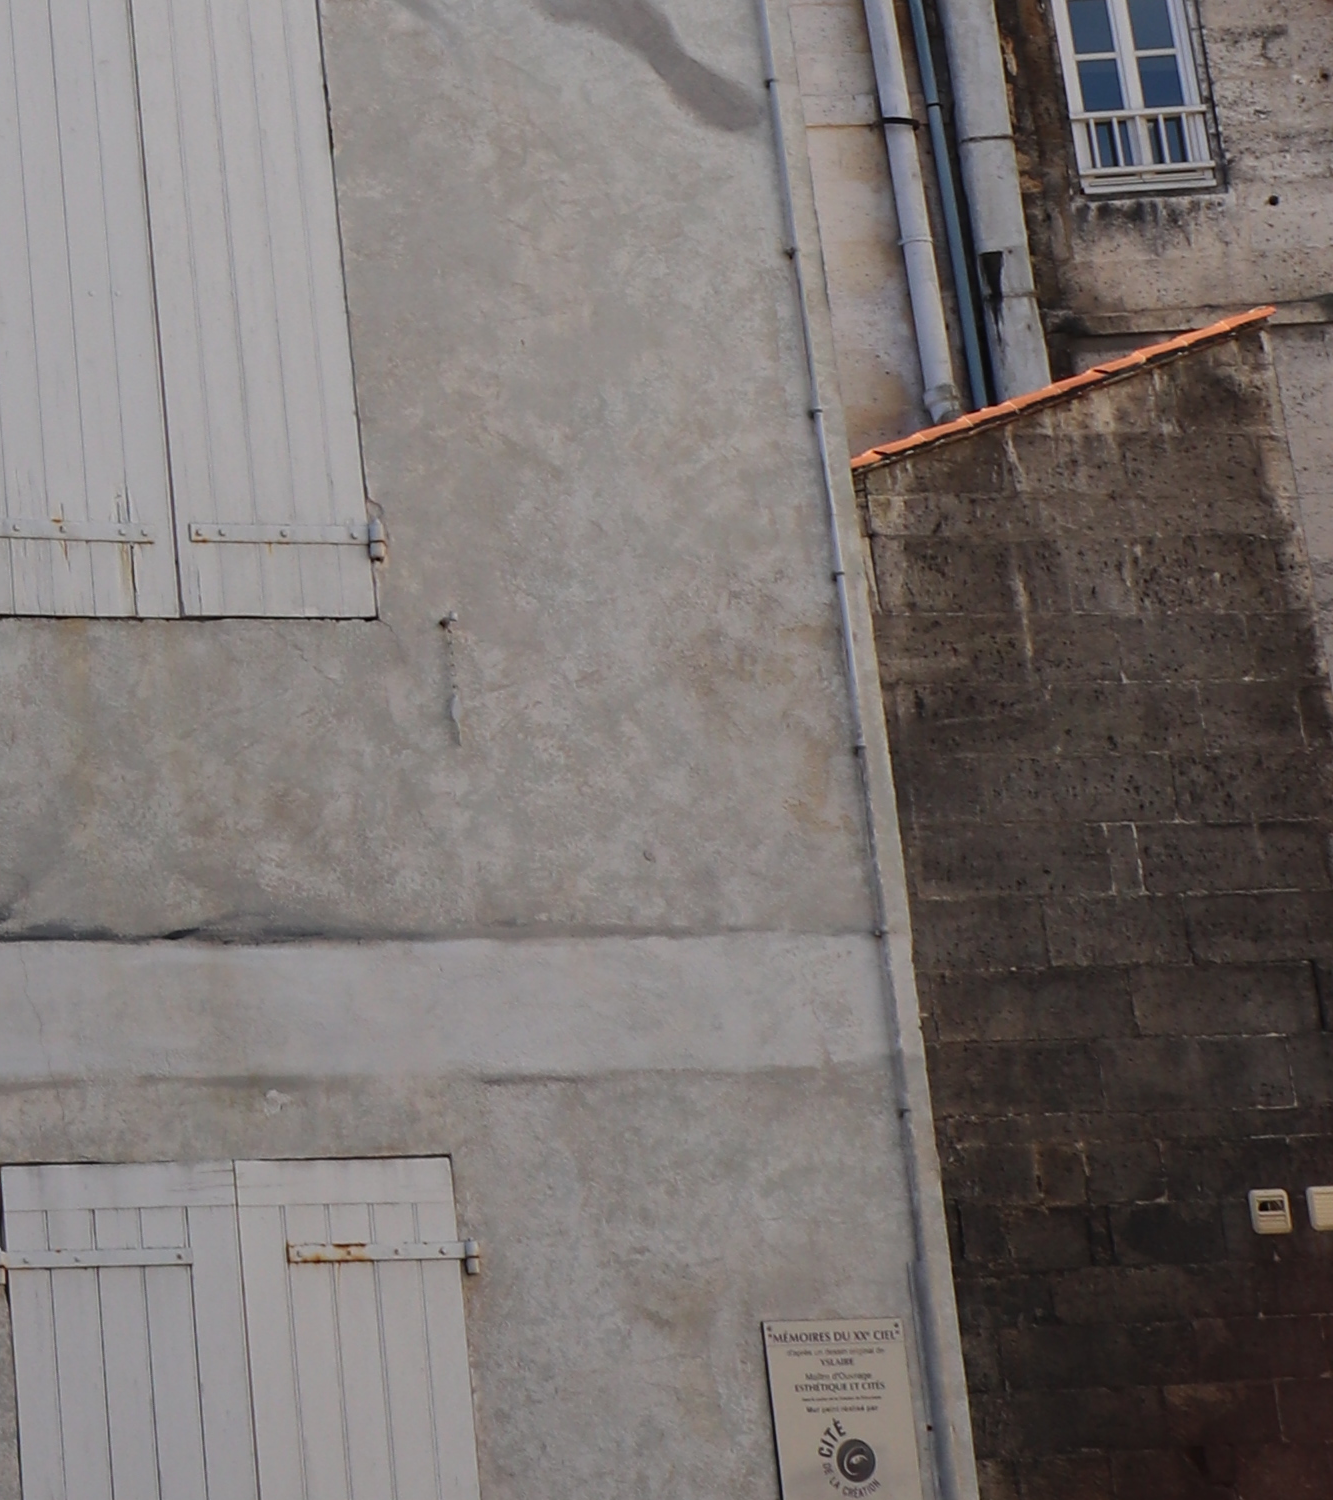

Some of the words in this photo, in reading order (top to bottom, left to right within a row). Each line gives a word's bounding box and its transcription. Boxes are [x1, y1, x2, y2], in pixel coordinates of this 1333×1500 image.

[833, 1331, 851, 1341] DU
[794, 1382, 848, 1393] ESTHÉTIQUE
[850, 1383, 860, 1391] ET
[861, 1381, 886, 1391] CITÉS
[818, 1417, 847, 1459] CITÉ
[829, 1477, 841, 1490] LA
[841, 1477, 882, 1499] CRÉATION
